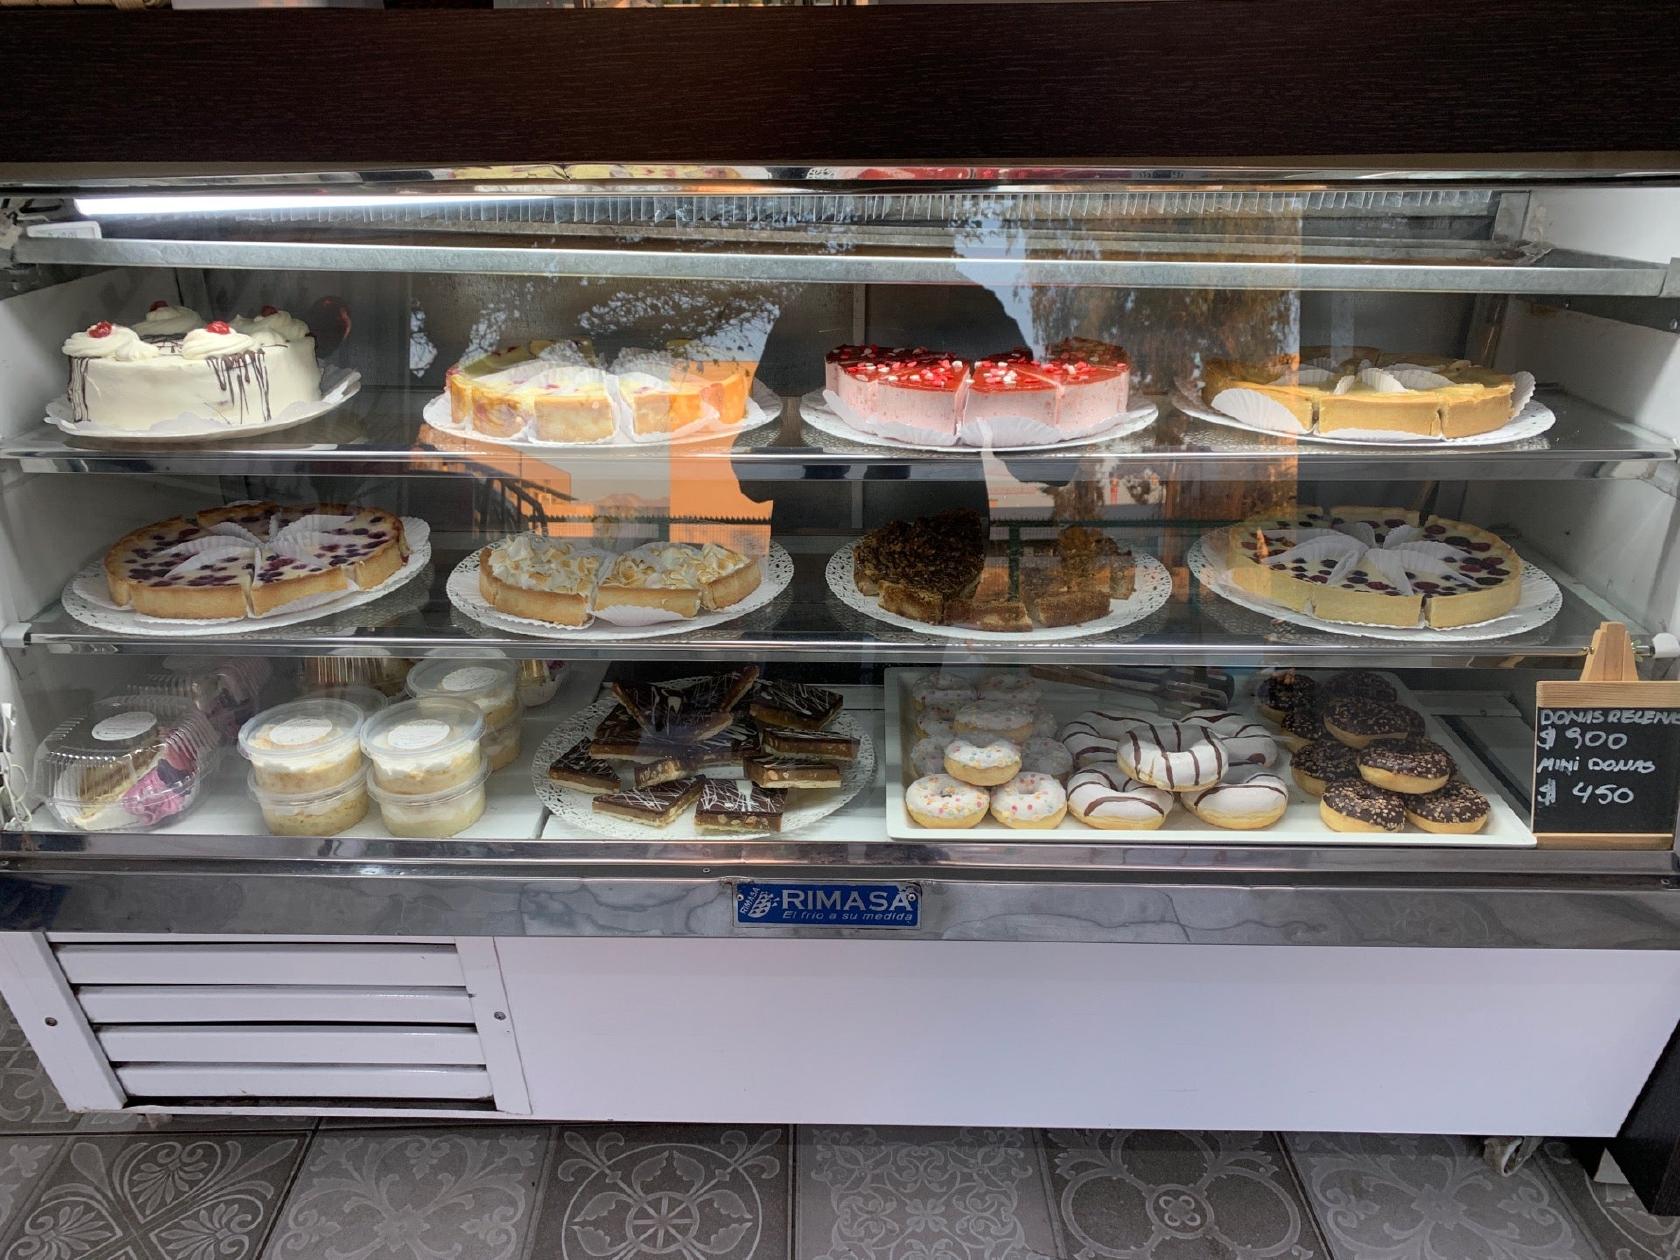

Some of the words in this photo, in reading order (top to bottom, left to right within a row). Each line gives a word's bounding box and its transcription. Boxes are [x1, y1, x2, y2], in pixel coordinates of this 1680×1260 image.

[1537, 726, 1556, 750] $
[1565, 727, 1628, 749] 900
[1537, 779, 1556, 806] $
[1572, 782, 1634, 805] 450
[739, 887, 761, 914] RIMASA
[782, 890, 913, 911] RIMASA
[782, 911, 796, 919] El
[862, 911, 913, 921] medida
